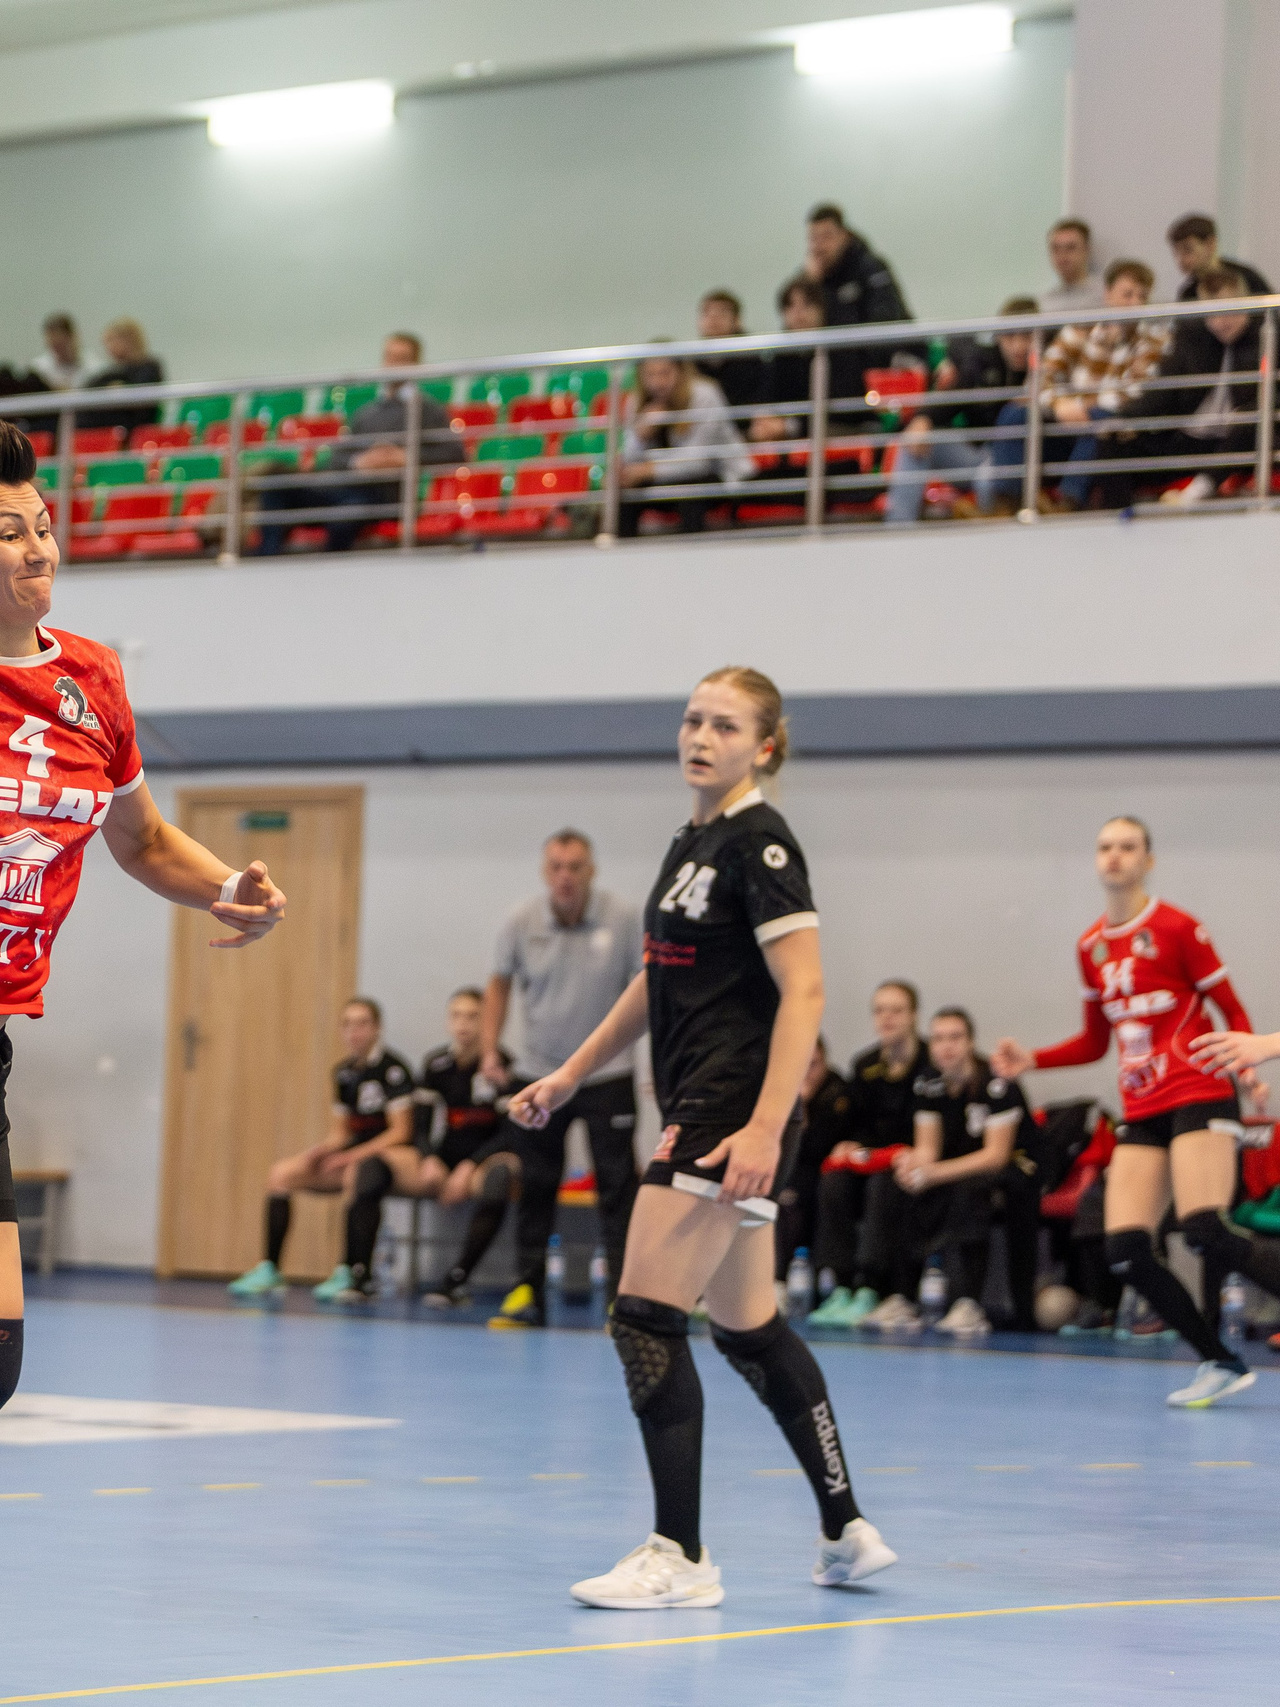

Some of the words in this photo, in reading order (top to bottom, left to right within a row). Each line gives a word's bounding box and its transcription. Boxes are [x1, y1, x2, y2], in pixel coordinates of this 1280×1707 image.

[8, 714, 56, 778] 4
[658, 861, 718, 921] 24
[811, 1401, 848, 1496] Kempa
